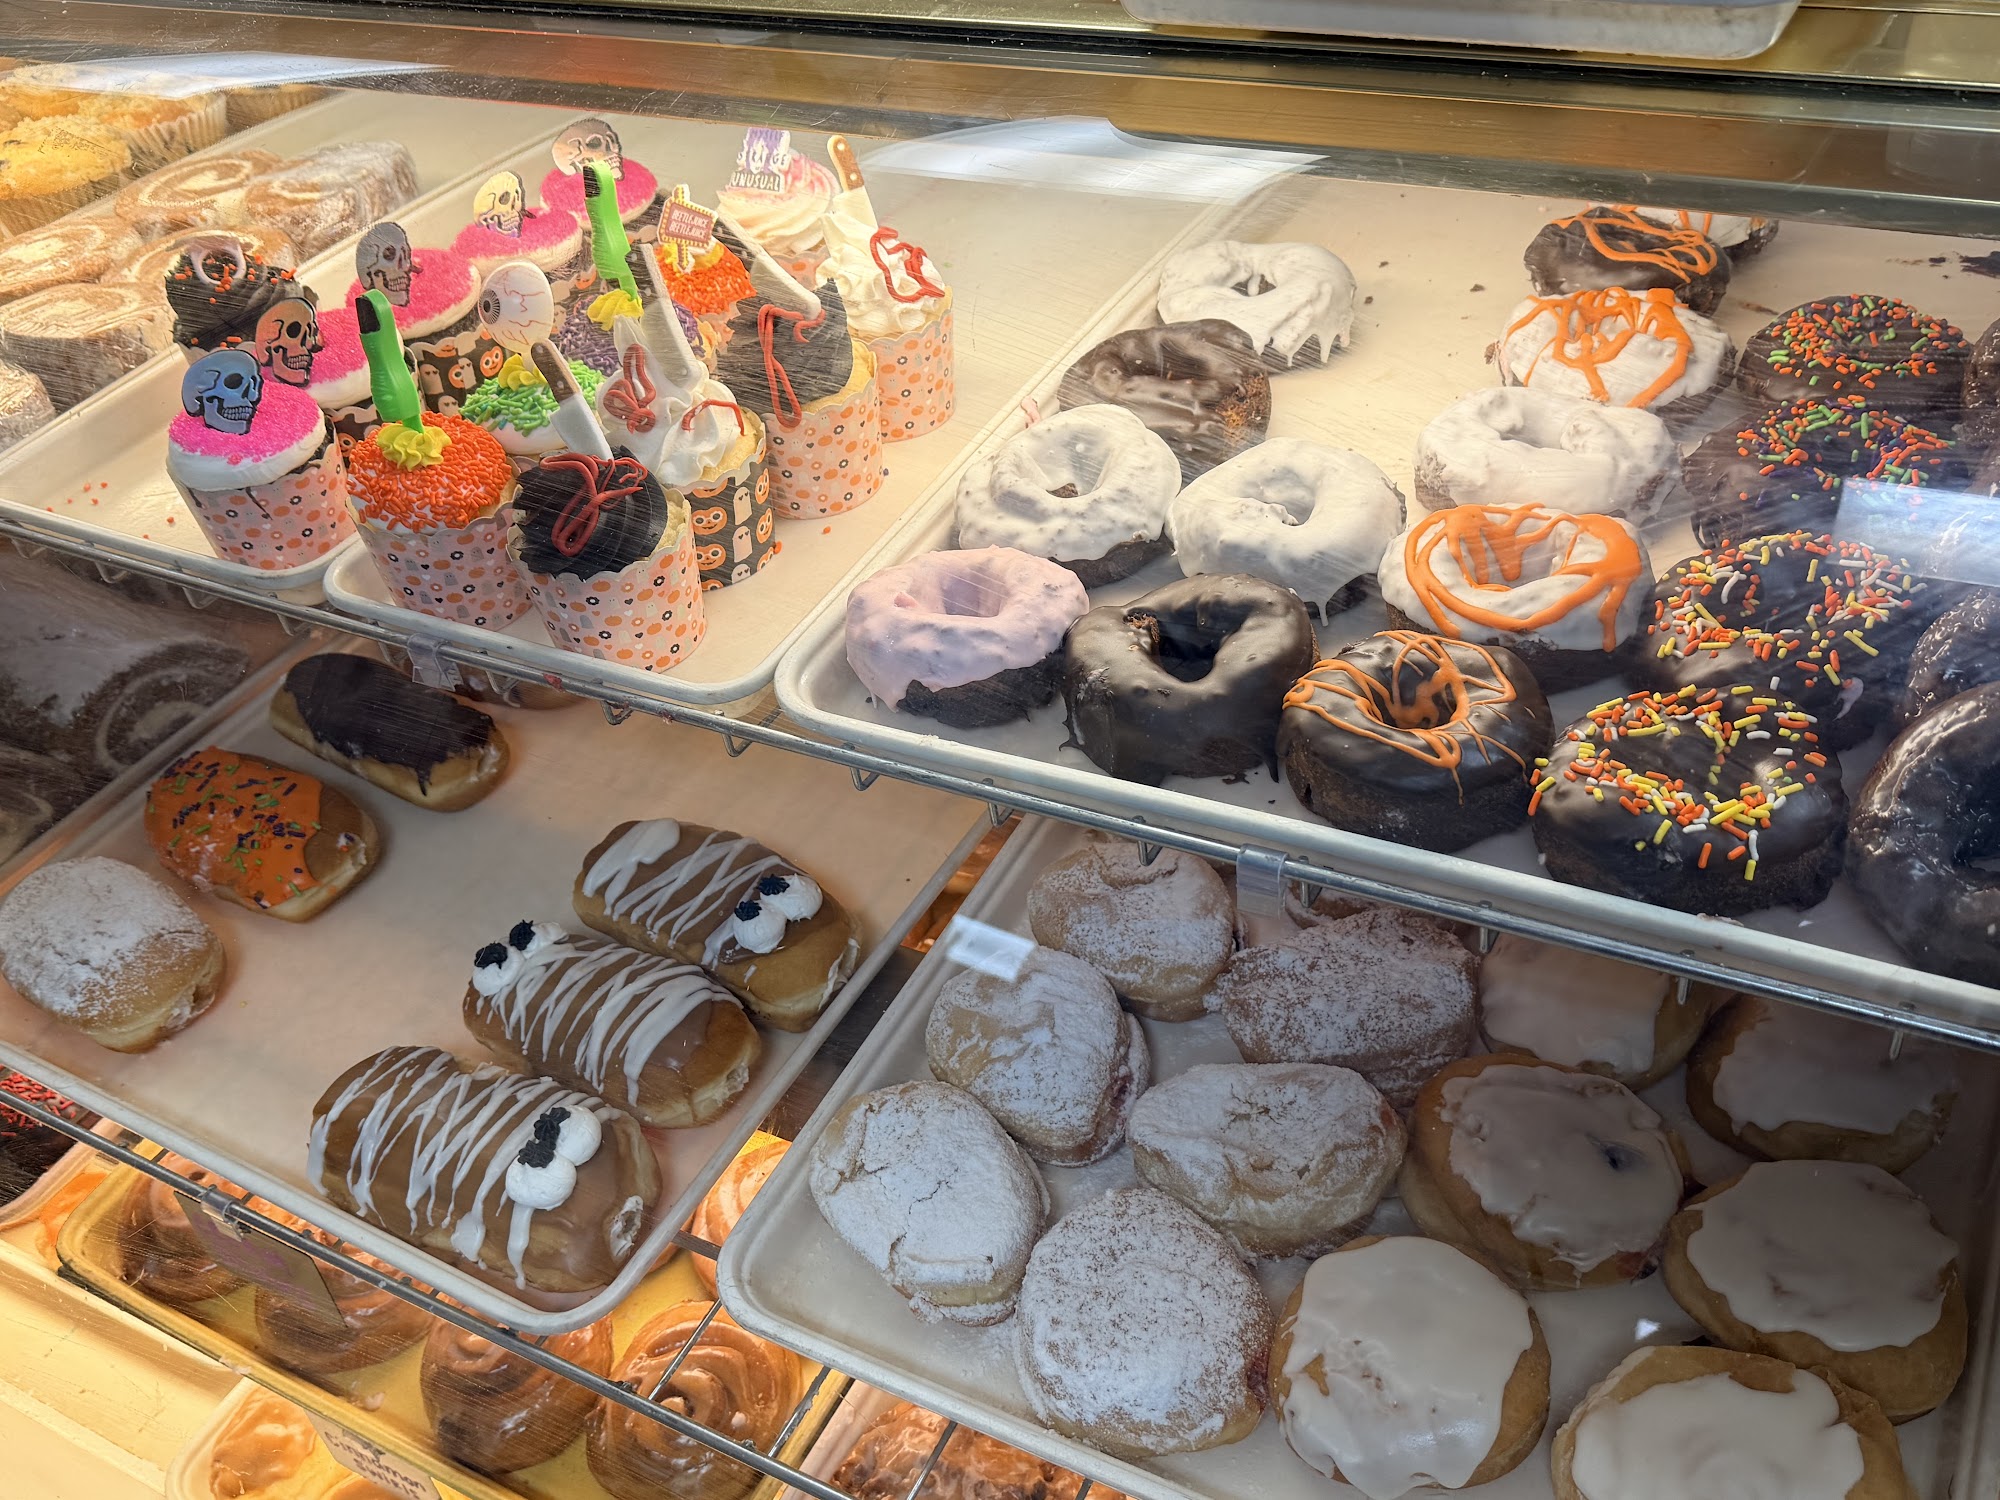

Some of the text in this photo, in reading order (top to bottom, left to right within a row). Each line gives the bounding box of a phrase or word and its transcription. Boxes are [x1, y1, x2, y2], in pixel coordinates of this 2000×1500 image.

[731, 170, 780, 190] UNUSUAL
[671, 209, 708, 228] BEETLEJUICE
[668, 221, 706, 239] BEETLEJUICE
[324, 1431, 427, 1492] Cinnamon
